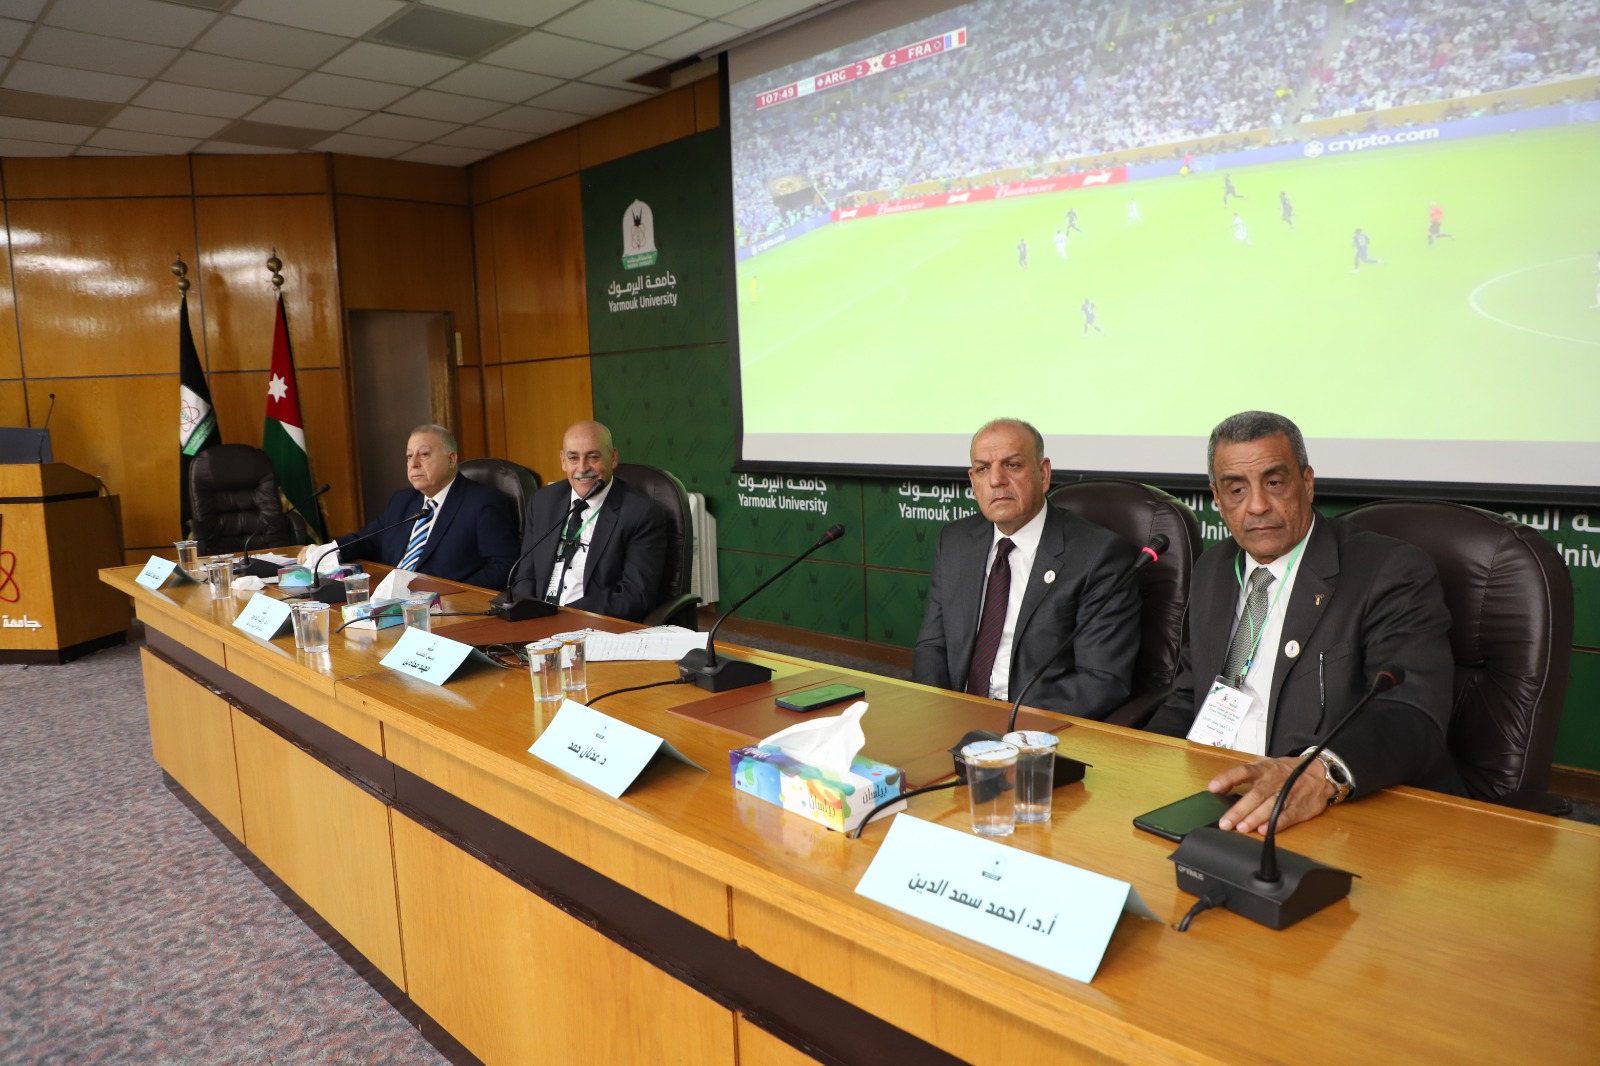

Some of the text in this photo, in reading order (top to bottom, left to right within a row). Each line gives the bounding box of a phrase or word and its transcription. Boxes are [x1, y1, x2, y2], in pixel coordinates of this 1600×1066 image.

[761, 43, 932, 105] 107:49 ARG 2 2 FRA
[1328, 128, 1439, 152] crypto.com
[995, 180, 1056, 198] Budweiser
[877, 199, 925, 214] Budweiser
[608, 271, 677, 298] جامعة اليرموك
[608, 292, 677, 313] Yarmouk University
[737, 473, 783, 493] اليرموك
[898, 481, 960, 503] اليرموك
[738, 493, 828, 515] Yarmouk University
[898, 503, 950, 521] Yarmouk
[567, 741, 582, 754] حمد
[579, 747, 600, 763] عدنان
[1177, 865, 1205, 881] OPTIMUS
[908, 873, 949, 896] الدين
[948, 888, 983, 910] سعد
[985, 902, 1026, 925] احمد
